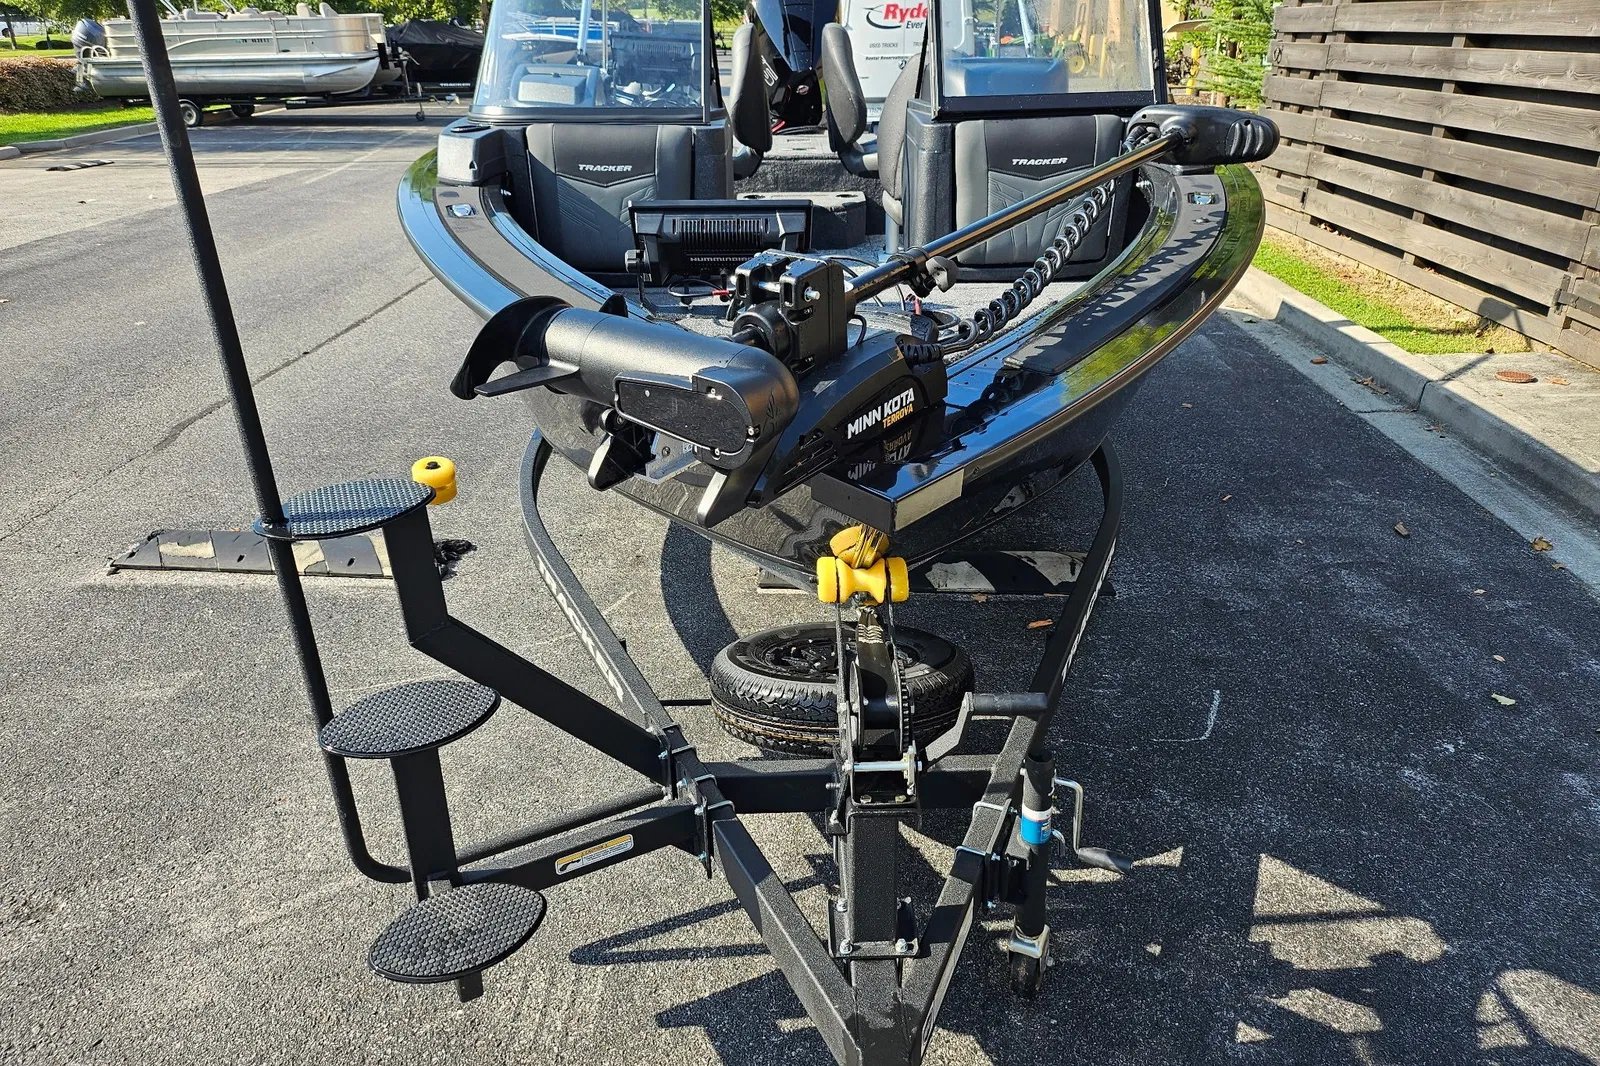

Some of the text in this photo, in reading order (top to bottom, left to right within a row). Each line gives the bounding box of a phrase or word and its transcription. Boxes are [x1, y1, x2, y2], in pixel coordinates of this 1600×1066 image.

[906, 20, 924, 30] Ever
[578, 163, 632, 172] TRACKER
[1012, 157, 1068, 166] TRACKER
[847, 387, 915, 440] MINN KOTA
[882, 404, 914, 429] TERROVA
[536, 554, 624, 703] TRACKER
